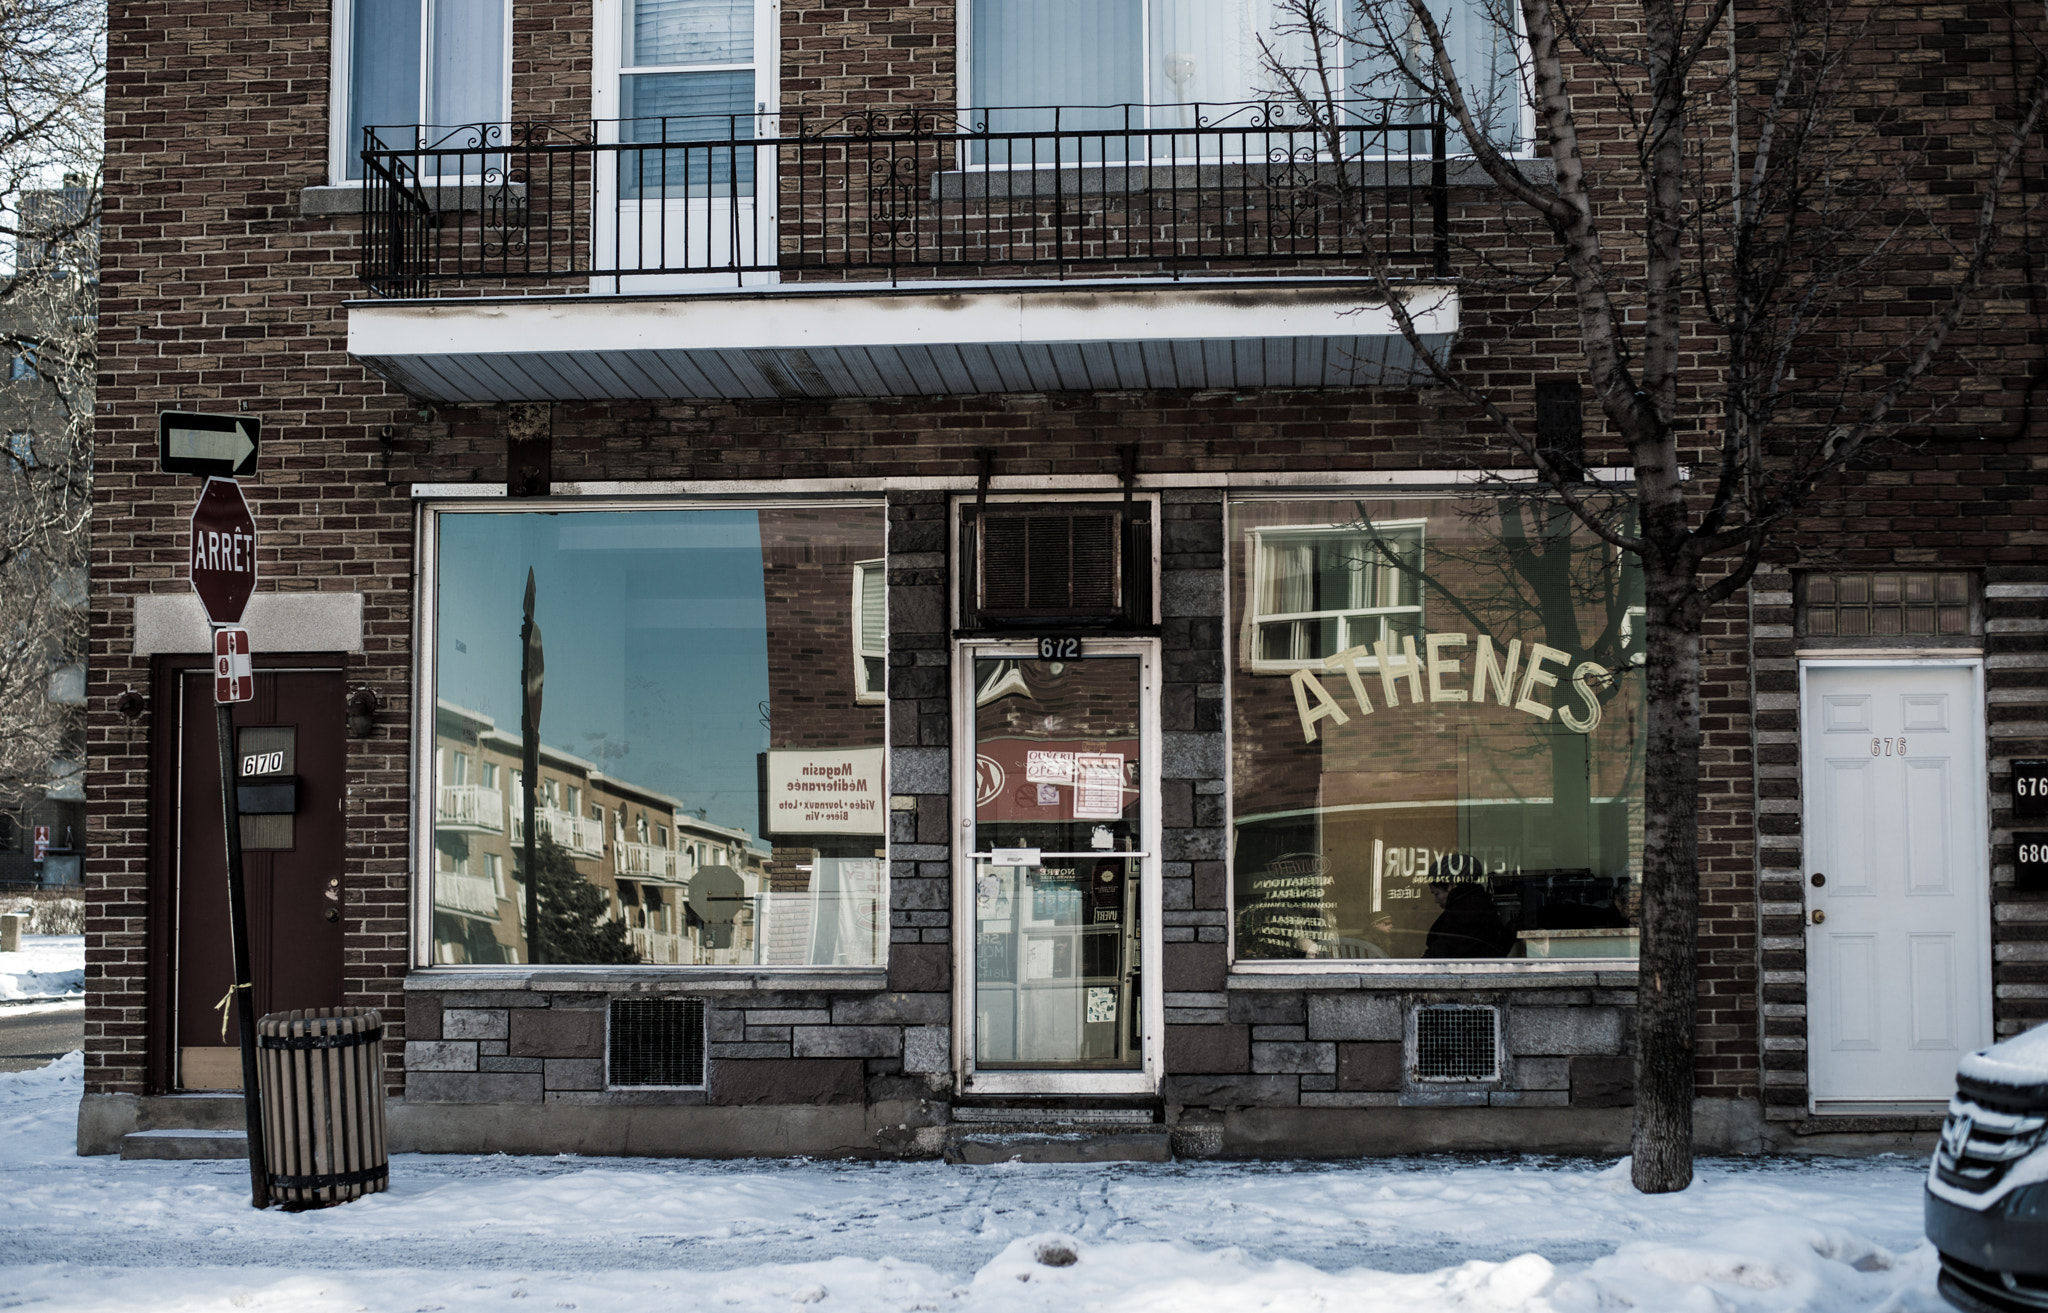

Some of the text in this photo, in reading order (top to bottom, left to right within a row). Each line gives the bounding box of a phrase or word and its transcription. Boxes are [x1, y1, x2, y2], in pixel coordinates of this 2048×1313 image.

[194, 526, 253, 573] ARRÊT
[1040, 637, 1079, 658] 672
[1289, 633, 1614, 744] ATHENES
[1029, 752, 1073, 760] OUVERT
[1871, 738, 1908, 757] 676
[245, 753, 282, 774] 670
[1028, 765, 1067, 776] OPEN
[2017, 777, 2048, 796] 676
[2019, 844, 2048, 863] 680
